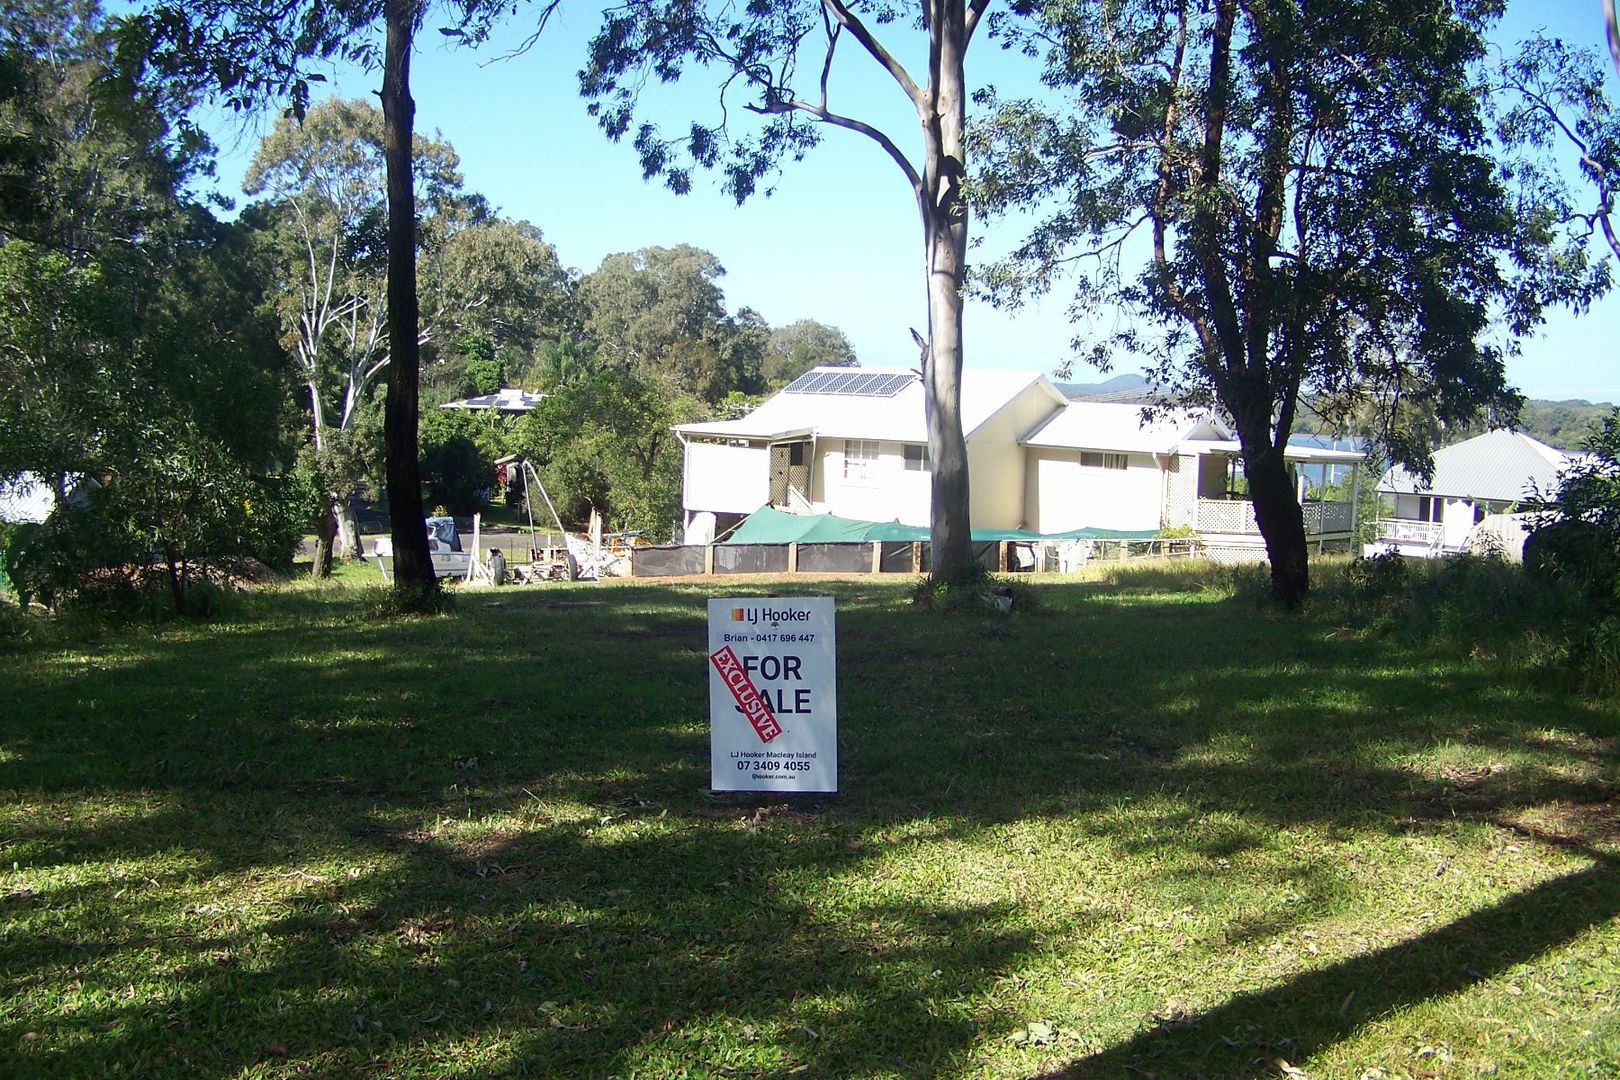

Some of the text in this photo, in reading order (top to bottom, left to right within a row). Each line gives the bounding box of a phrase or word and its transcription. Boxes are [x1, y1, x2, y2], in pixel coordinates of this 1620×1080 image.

[747, 608, 811, 625] LJ Hooker
[724, 634, 748, 642] Brian
[756, 634, 778, 642] 0417
[780, 634, 797, 642] 696
[798, 634, 815, 642] 447
[743, 655, 802, 681] FOR
[714, 648, 778, 740] EXCLUSIVE
[740, 751, 765, 759] Hooker
[766, 752, 795, 760] Macleay
[796, 751, 817, 759] Island
[737, 761, 810, 771] 07 3409 4055
